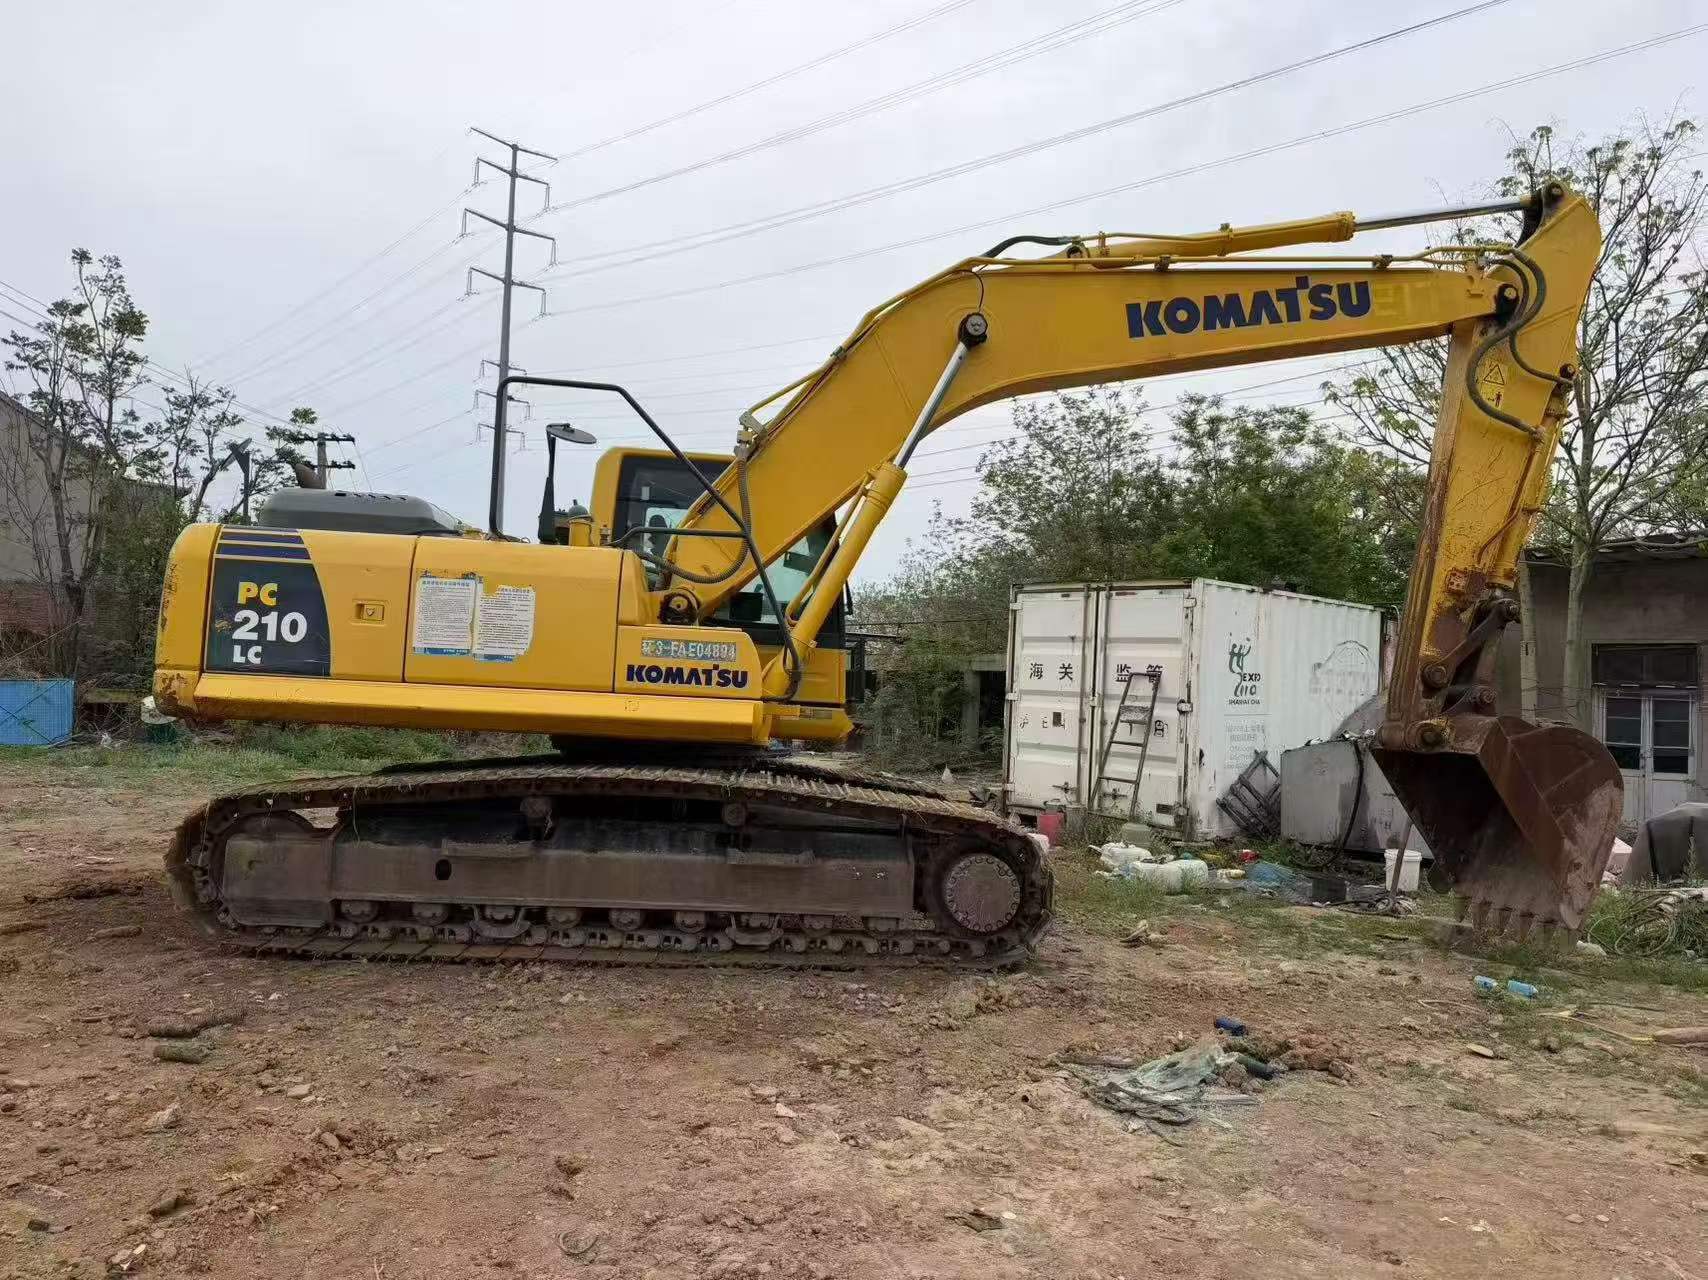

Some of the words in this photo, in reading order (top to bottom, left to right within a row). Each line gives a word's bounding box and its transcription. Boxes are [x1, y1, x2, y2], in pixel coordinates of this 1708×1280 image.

[1125, 276, 1370, 339] KOMATSU
[237, 581, 278, 606] PC
[231, 609, 308, 643] 210
[232, 645, 263, 665] LC
[626, 664, 748, 689] KOMATSU
[1029, 662, 1073, 681] 海关
